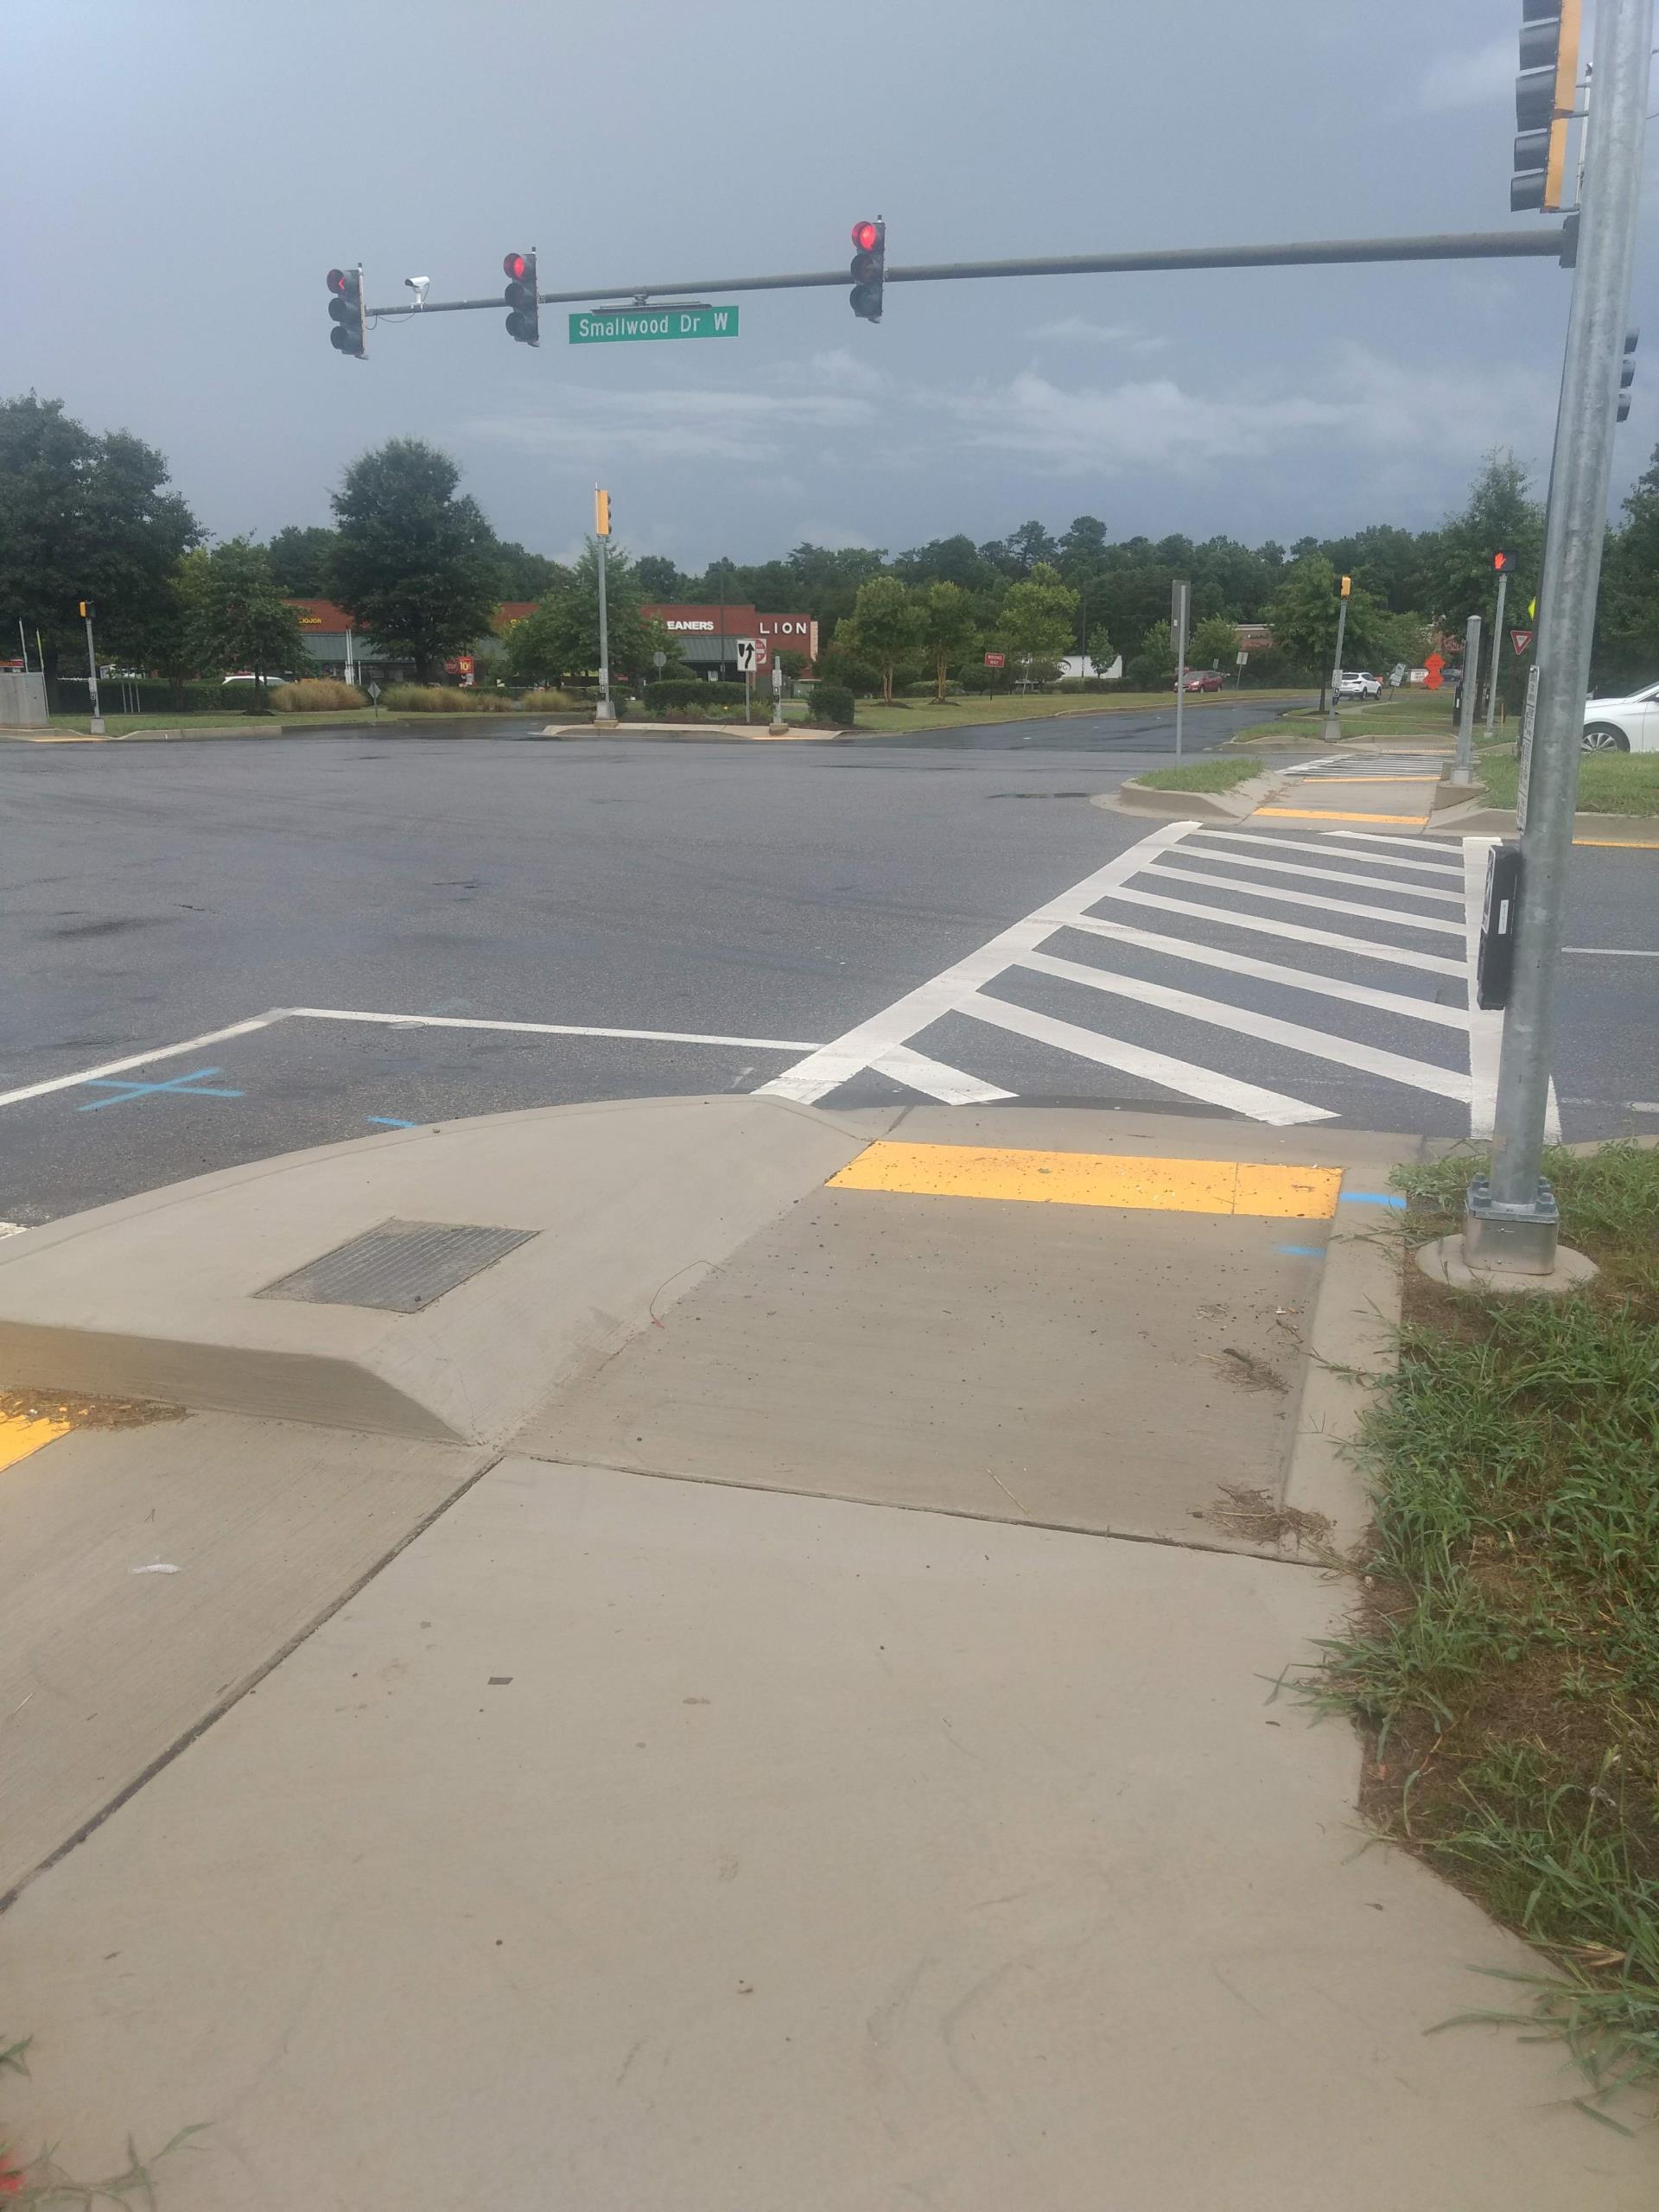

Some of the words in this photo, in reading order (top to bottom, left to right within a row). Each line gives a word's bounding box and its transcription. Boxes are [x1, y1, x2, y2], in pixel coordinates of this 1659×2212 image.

[579, 315, 669, 337] Smallwood
[680, 314, 701, 333] Dr
[714, 312, 728, 331] W
[653, 620, 715, 631] EANERS
[760, 622, 807, 634] LION
